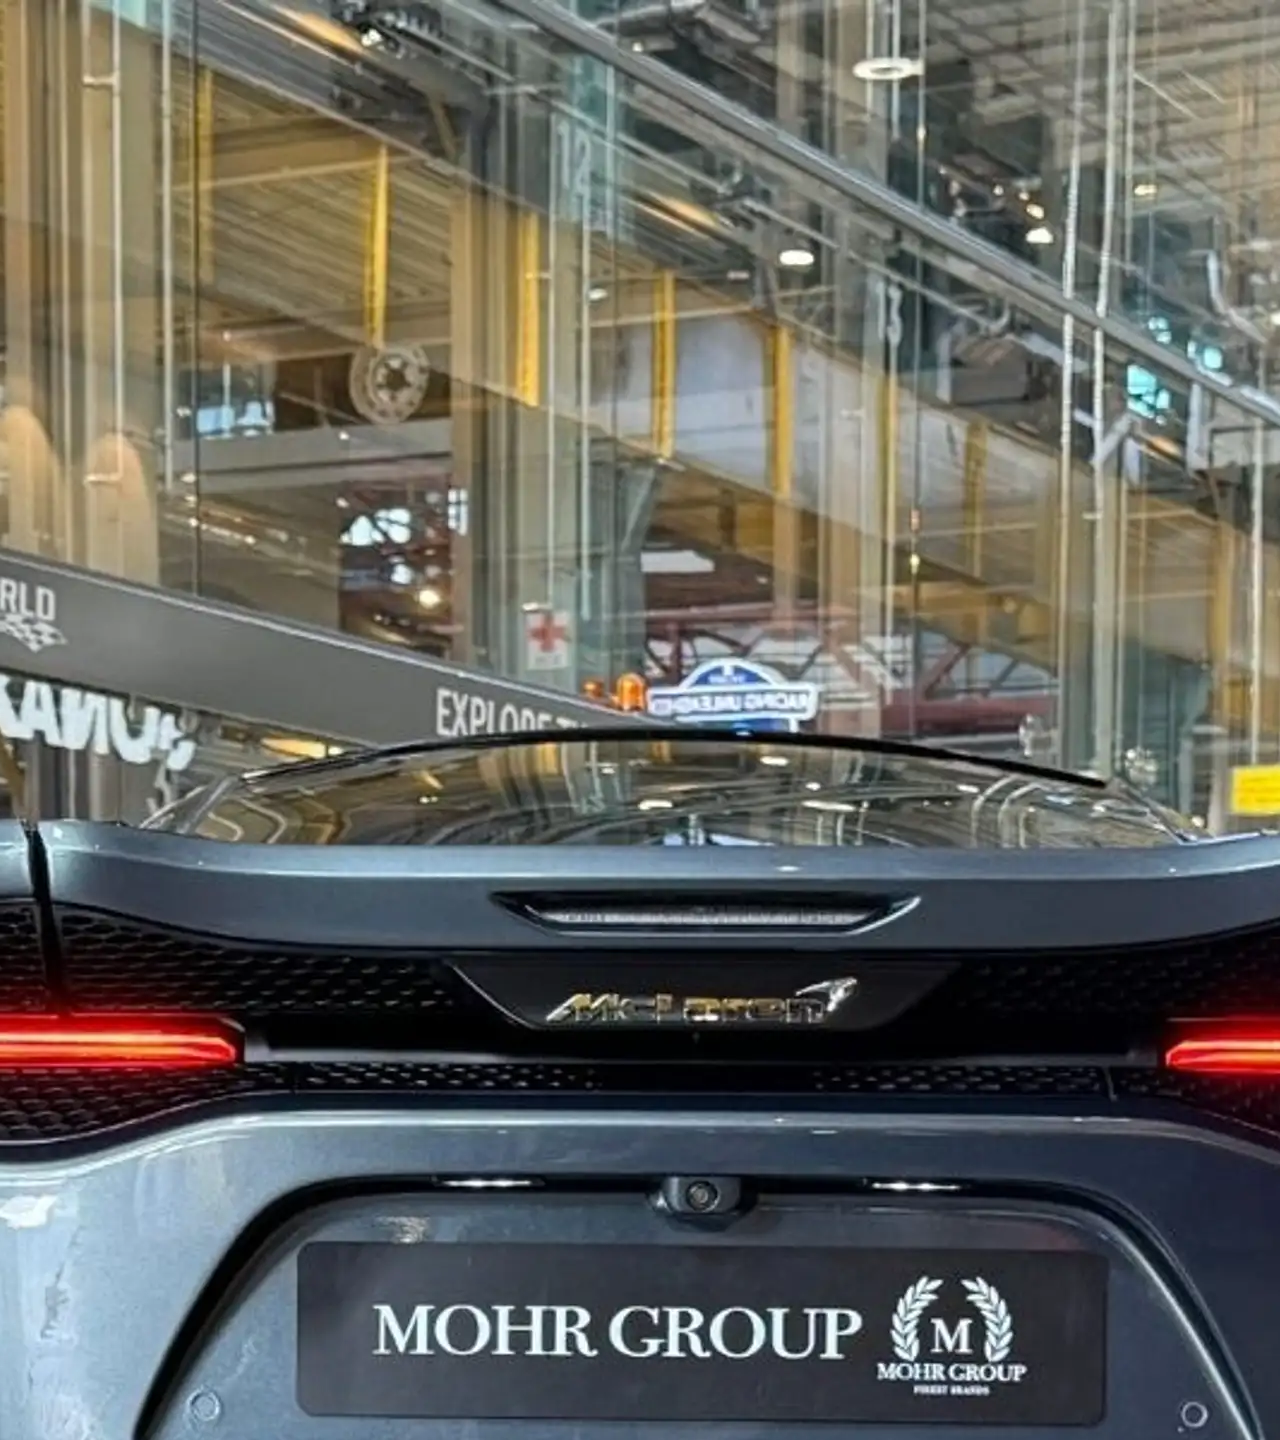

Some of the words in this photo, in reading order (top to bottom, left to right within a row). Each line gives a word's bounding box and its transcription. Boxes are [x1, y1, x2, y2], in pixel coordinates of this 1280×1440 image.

[546, 993, 829, 1023] McLaren
[372, 1304, 598, 1357] MOHR
[608, 1306, 864, 1360] GROUP
[930, 1318, 973, 1354] M
[877, 1362, 946, 1381] MOHR
[948, 1362, 1027, 1382] GROUP
